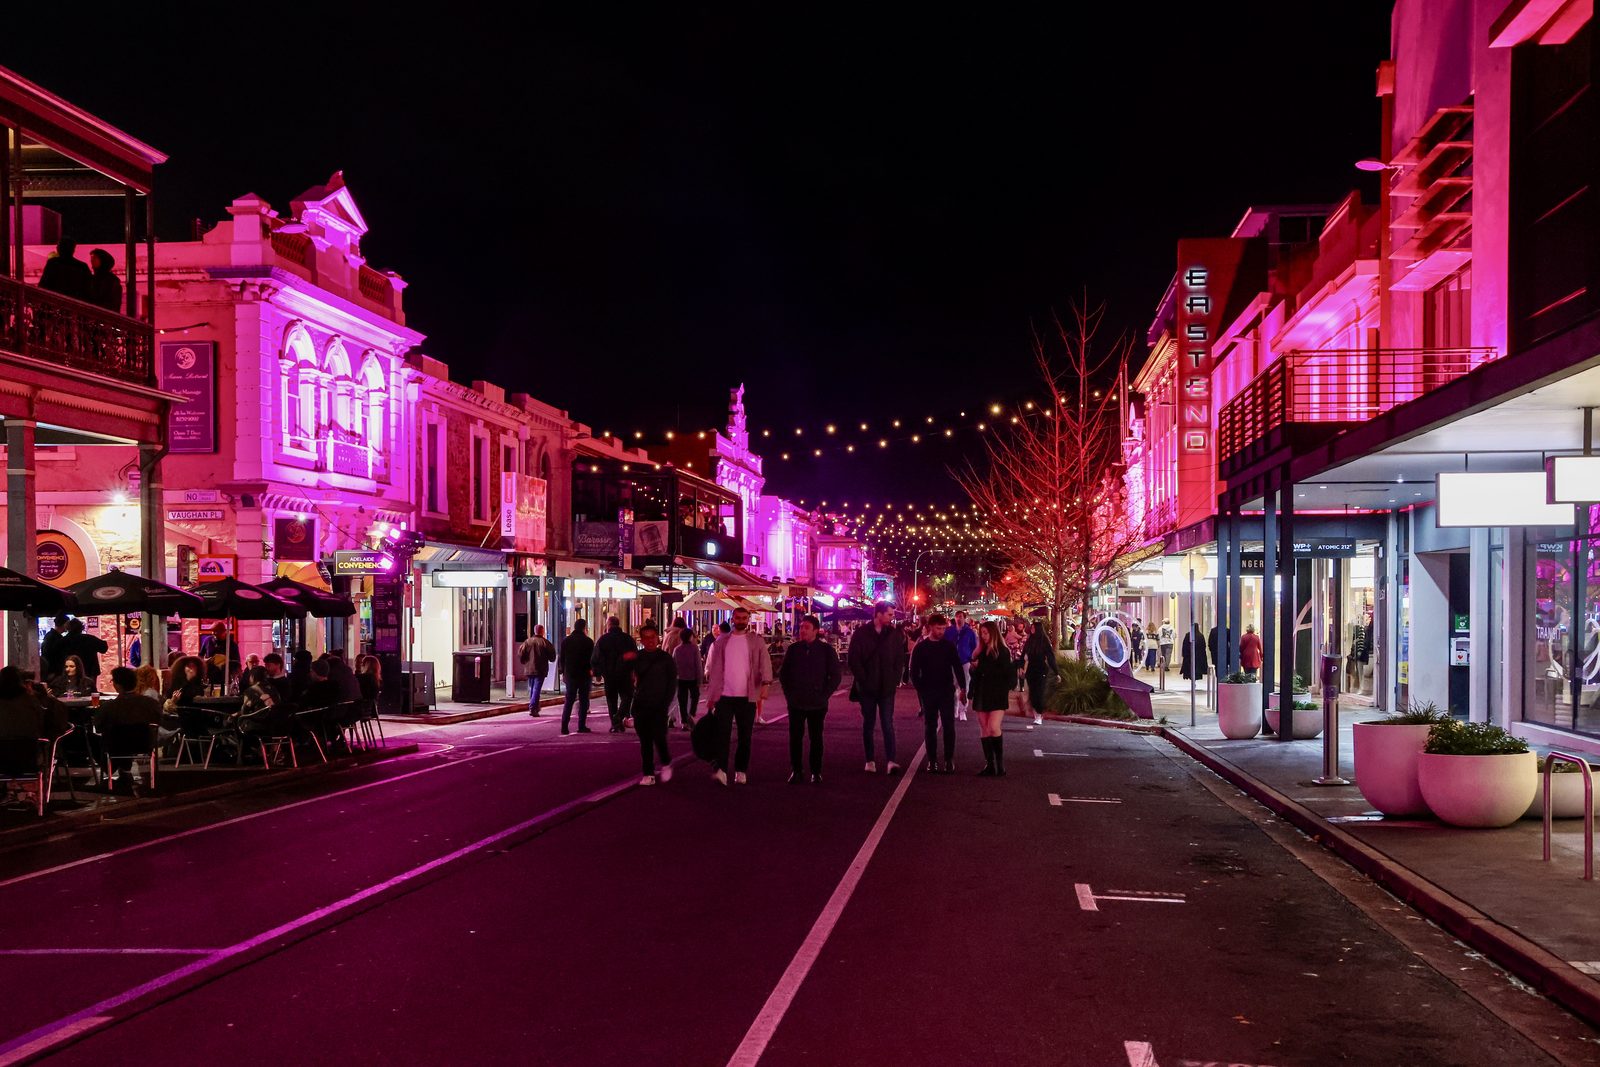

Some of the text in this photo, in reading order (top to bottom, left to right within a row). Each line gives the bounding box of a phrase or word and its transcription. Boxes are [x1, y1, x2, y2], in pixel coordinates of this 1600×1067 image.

[186, 493, 198, 501] NO
[505, 509, 513, 533] Lease
[1331, 665, 1338, 673] P
